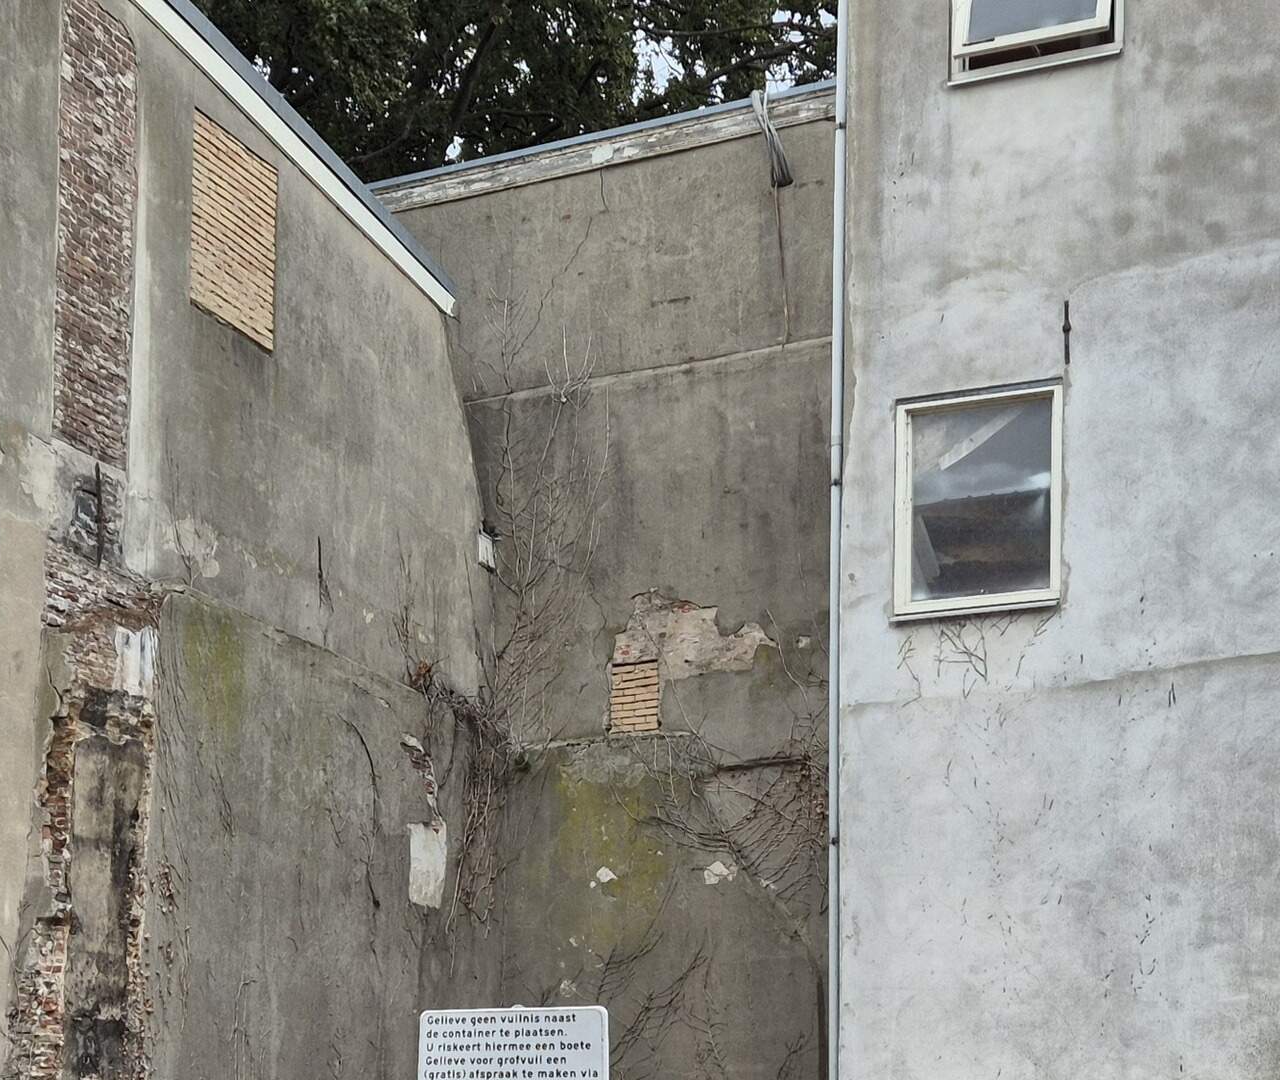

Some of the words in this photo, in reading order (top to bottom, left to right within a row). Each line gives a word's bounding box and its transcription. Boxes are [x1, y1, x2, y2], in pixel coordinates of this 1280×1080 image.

[427, 1015, 467, 1025] Gelieve
[470, 1016, 496, 1026] geen
[501, 1013, 540, 1023] vuilnis
[544, 1013, 576, 1022] naast
[426, 1029, 439, 1038] de
[442, 1029, 496, 1038] container
[500, 1028, 510, 1037] te
[514, 1028, 568, 1038] plaatsen.
[426, 1043, 434, 1052] U
[438, 1042, 480, 1051] riskeert
[485, 1042, 531, 1051] hiermee
[535, 1043, 555, 1051] een
[560, 1041, 591, 1050] boete
[425, 1056, 466, 1065] Gelieve
[469, 1057, 494, 1065] voor
[497, 1055, 542, 1067] grofvuil
[546, 1056, 567, 1065] een
[423, 1070, 466, 1080] (gratis)
[469, 1069, 518, 1080] afspraak
[522, 1069, 533, 1078] te
[537, 1068, 576, 1078] maken
[581, 1068, 598, 1078] via
